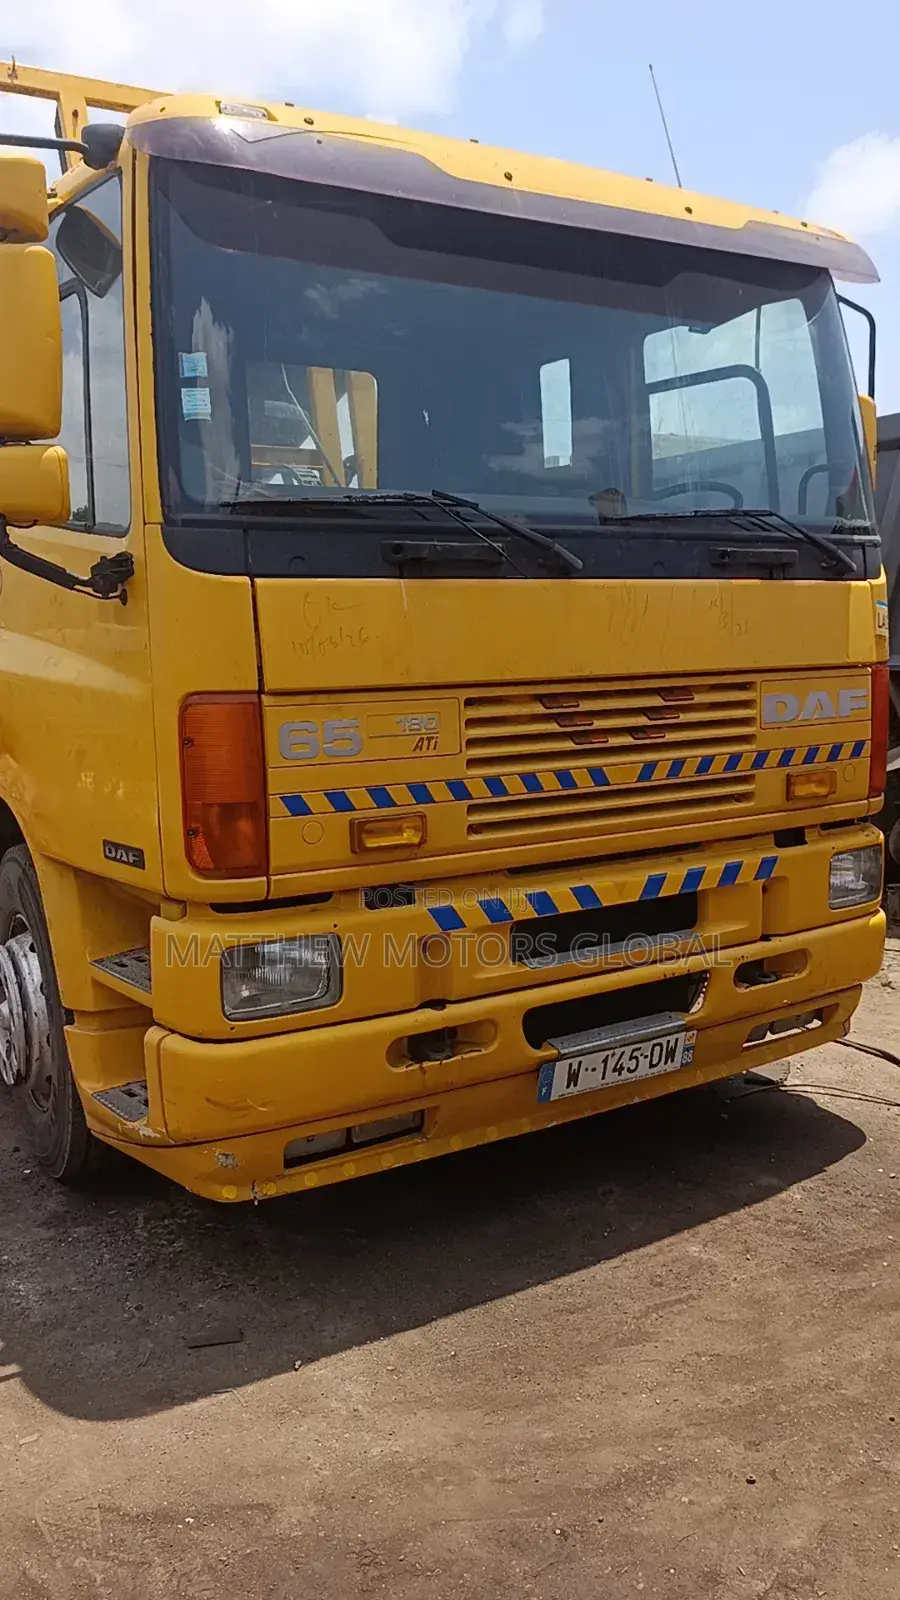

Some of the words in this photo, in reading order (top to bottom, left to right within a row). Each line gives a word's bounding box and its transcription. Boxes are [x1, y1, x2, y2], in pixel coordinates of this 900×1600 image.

[763, 688, 868, 723] DAF
[278, 719, 363, 760] 65
[395, 714, 439, 734] 180
[412, 735, 440, 752] ATi
[105, 845, 141, 863] DAF
